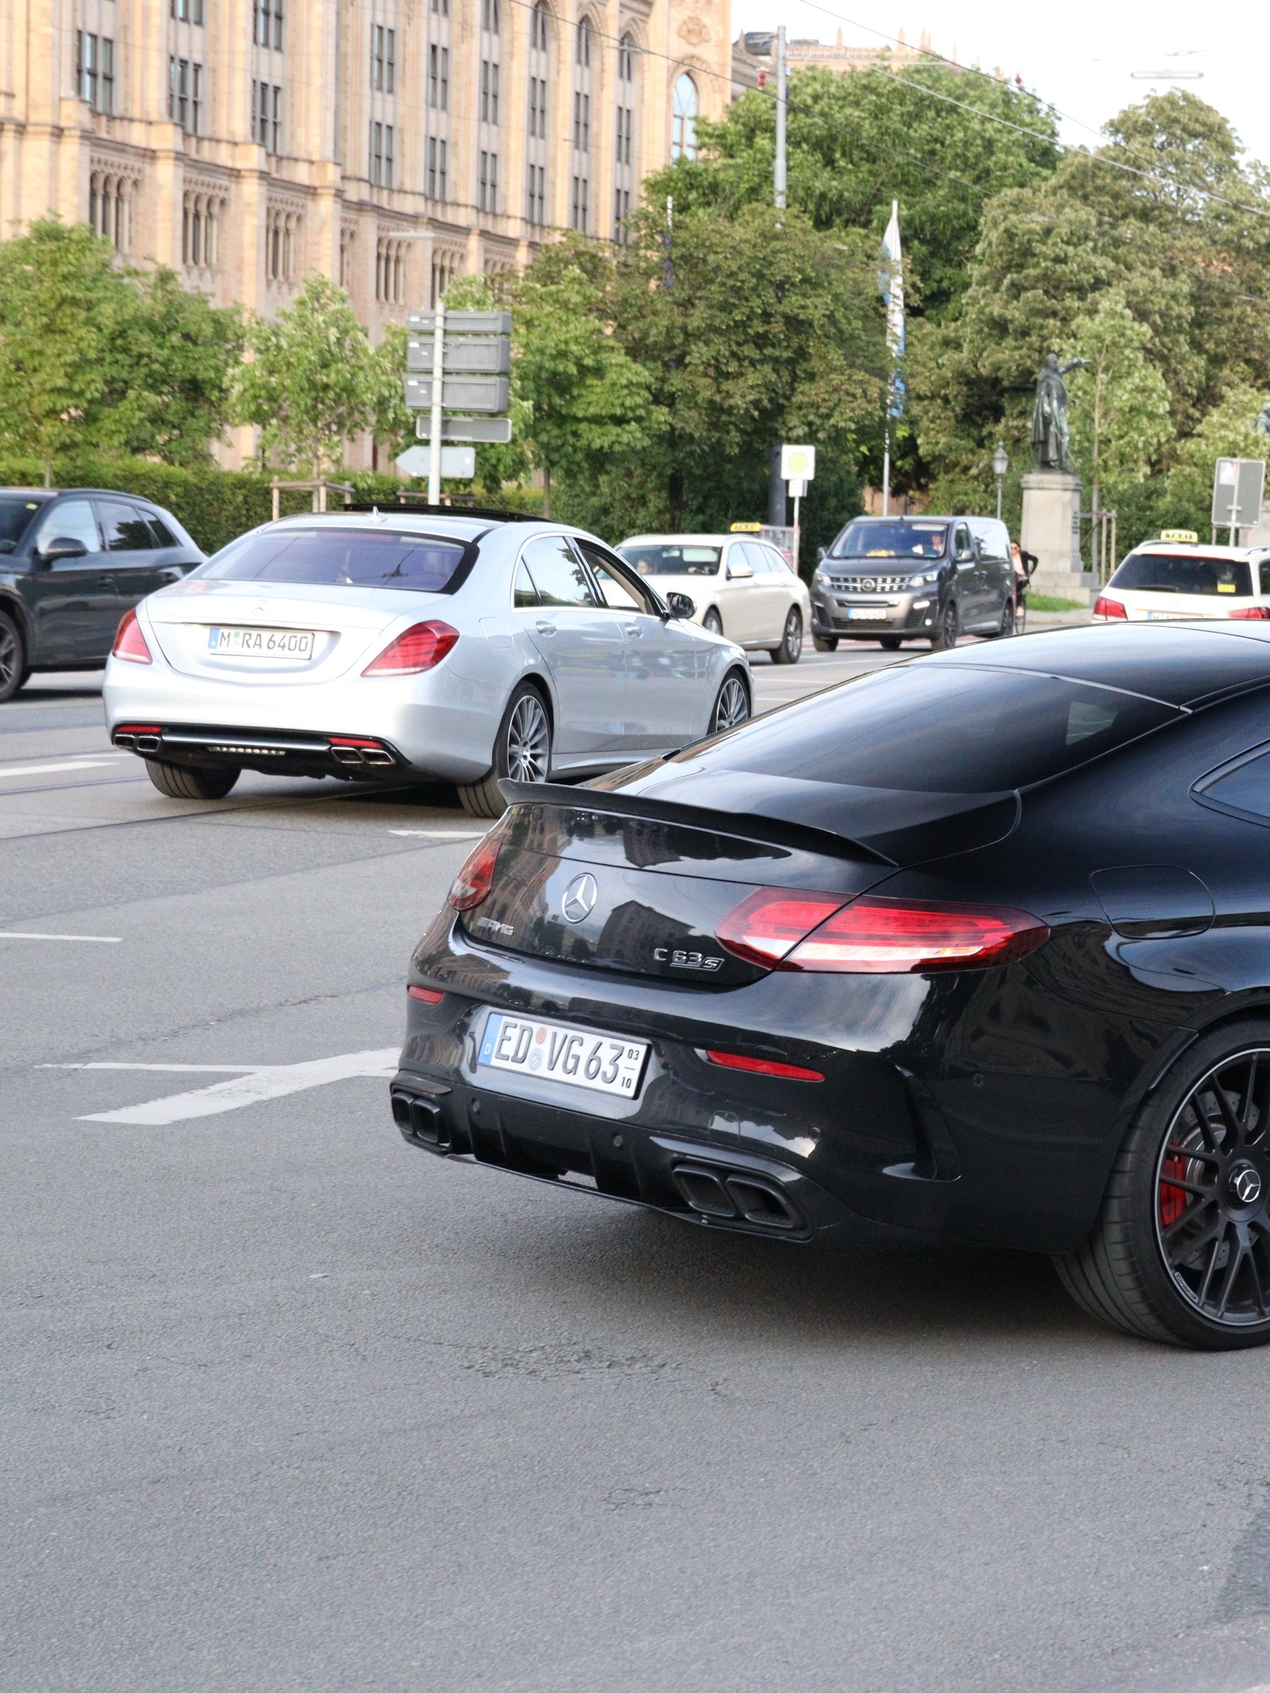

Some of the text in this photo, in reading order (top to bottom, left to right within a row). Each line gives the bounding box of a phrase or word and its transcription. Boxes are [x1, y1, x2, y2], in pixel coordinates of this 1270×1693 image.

[219, 631, 308, 652] M RA 6400
[653, 947, 668, 962] C
[494, 1021, 534, 1064] ED
[483, 1045, 492, 1056] D
[627, 1048, 640, 1061] 03
[621, 1076, 632, 1089] 10
